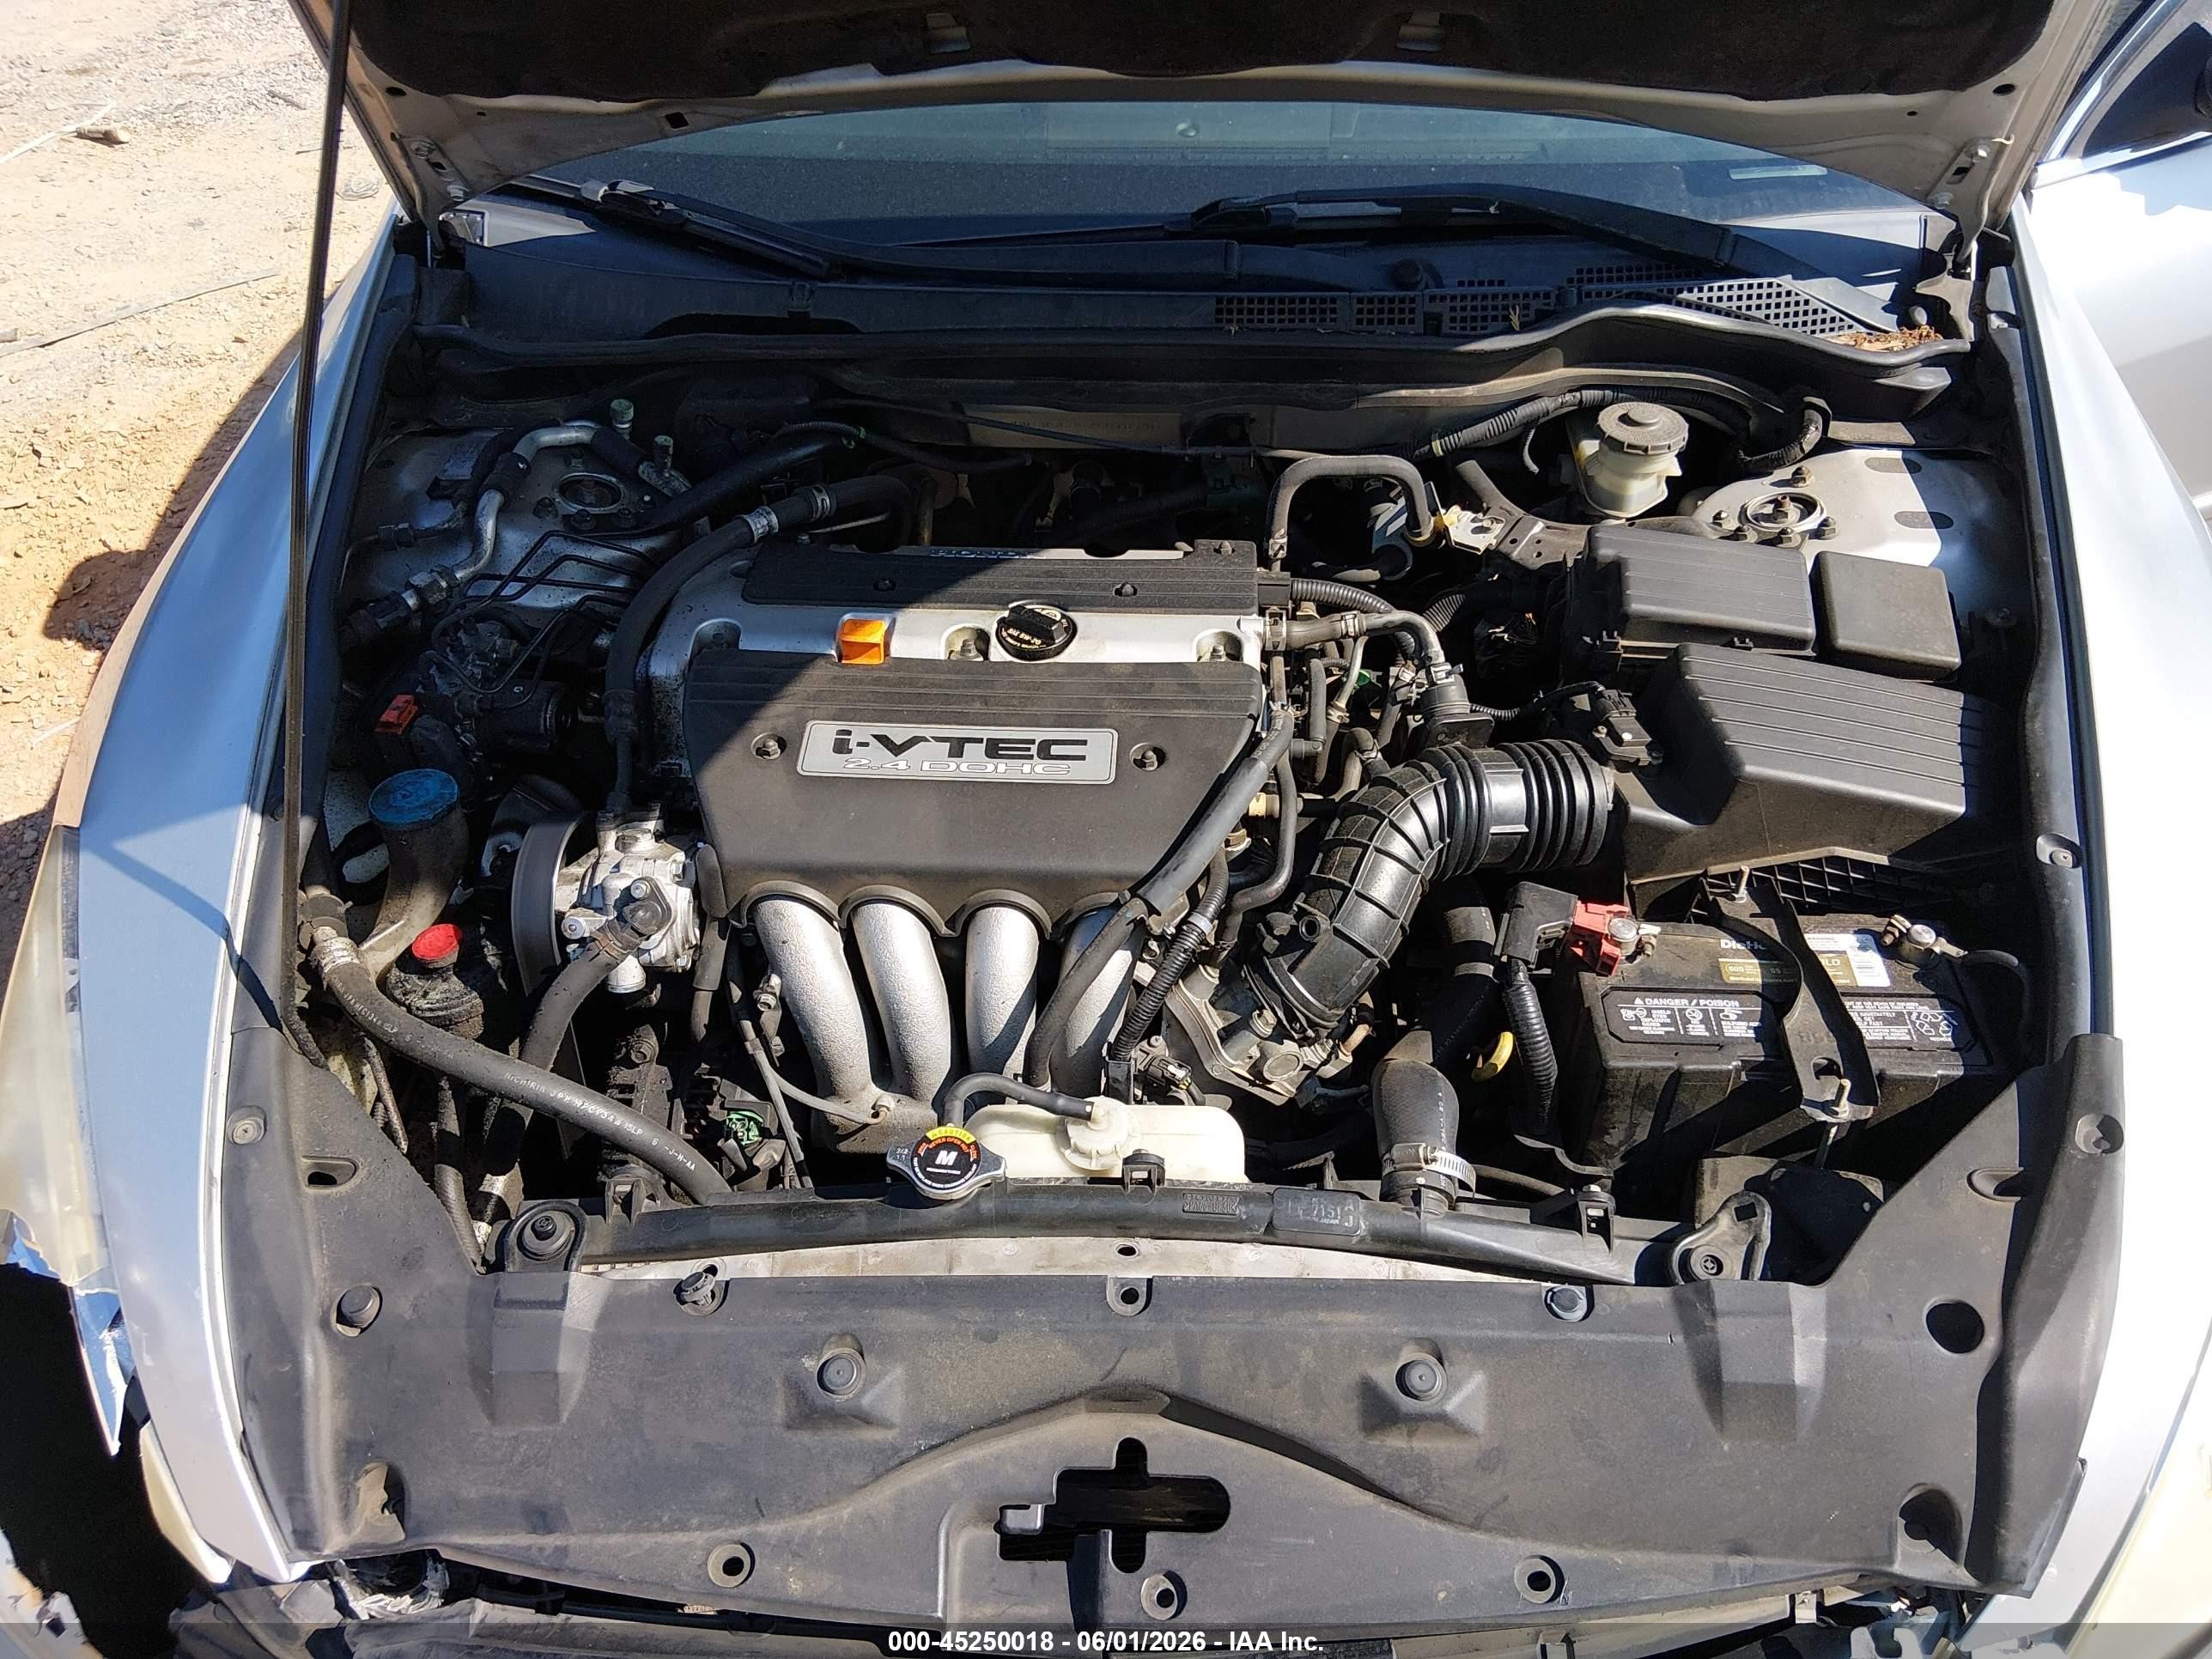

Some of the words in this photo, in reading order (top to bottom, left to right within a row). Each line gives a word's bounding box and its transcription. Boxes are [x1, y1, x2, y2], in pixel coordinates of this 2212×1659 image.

[832, 729, 1088, 761] i-VTEC
[843, 757, 910, 772] 2.4
[921, 759, 1071, 775] DOHC
[1699, 999, 1740, 1007] POISON
[938, 1128, 971, 1142] CAUTION
[934, 1150, 958, 1166] M
